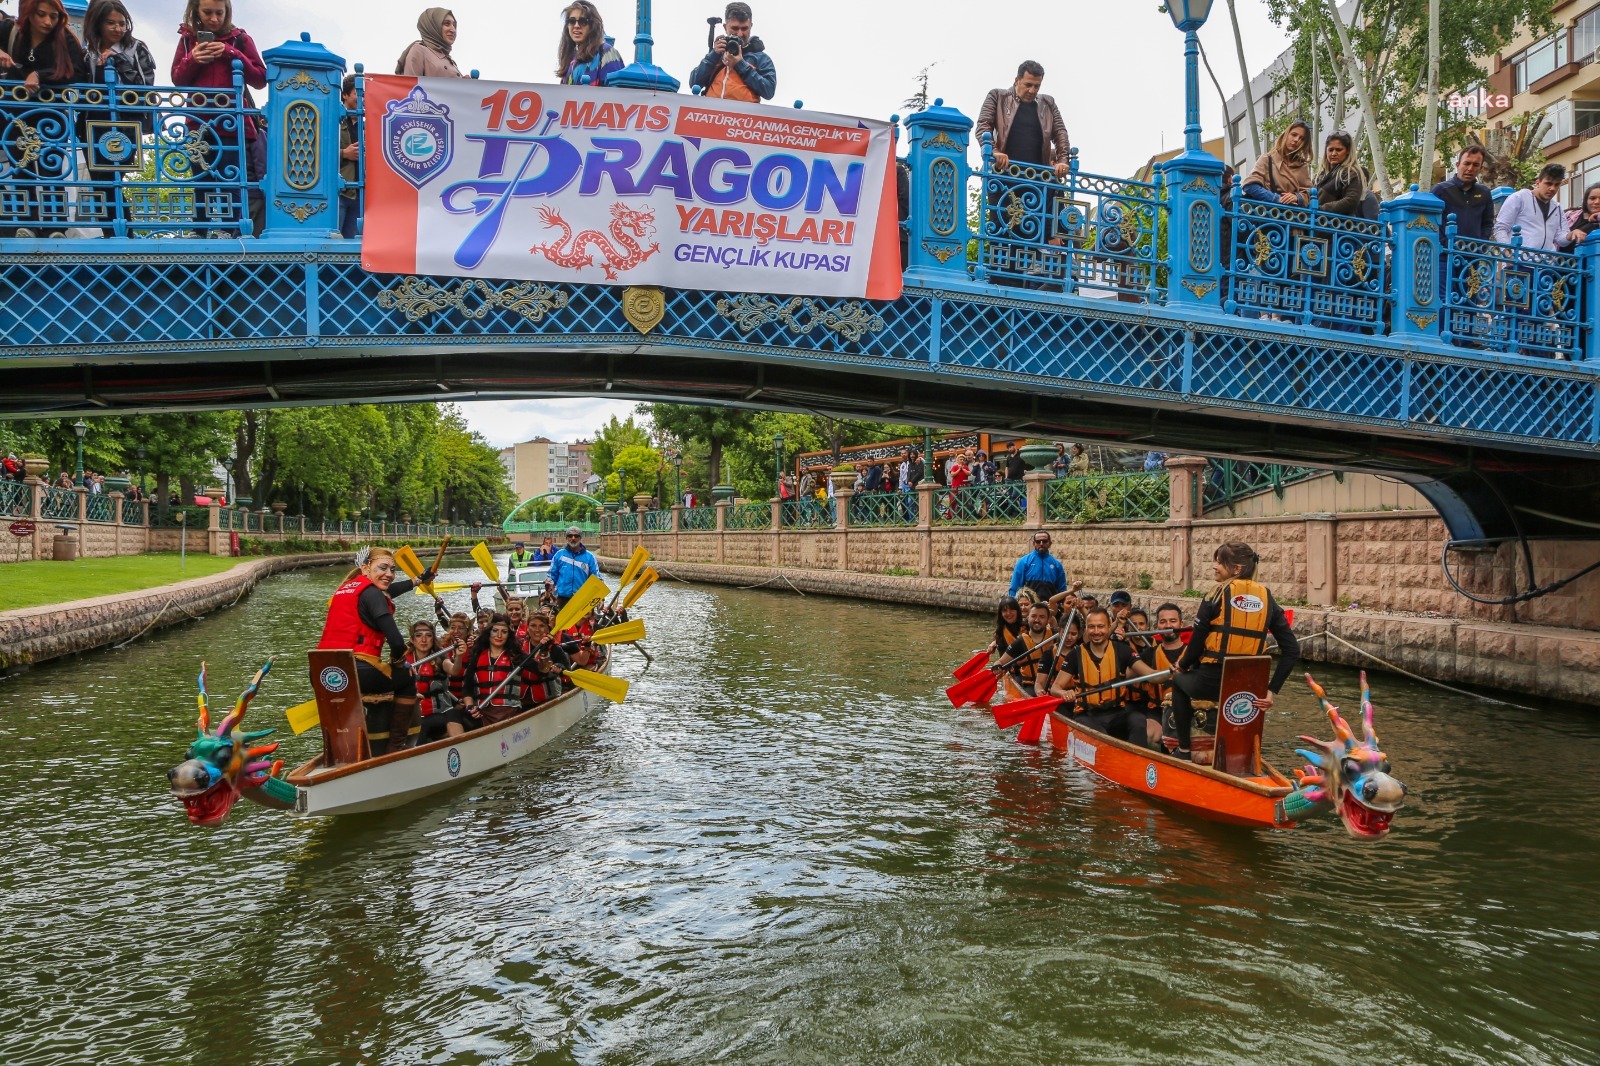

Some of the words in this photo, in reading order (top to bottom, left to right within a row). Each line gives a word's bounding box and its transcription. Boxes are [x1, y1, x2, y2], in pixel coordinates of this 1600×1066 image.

[481, 89, 543, 132] 19
[560, 100, 671, 131] MAYIS
[401, 120, 436, 133] ESKİŞEHİR
[726, 128, 762, 142] SPOR
[763, 131, 818, 148] BAYRAMI
[754, 120, 790, 134] ANMA
[792, 125, 845, 141] GENÇLİK
[845, 131, 863, 142] VE
[440, 130, 865, 217] DRAGON
[676, 204, 856, 246] YARIŞLARI
[674, 243, 771, 269] GENÇLİK
[773, 250, 852, 273] KUPASI
